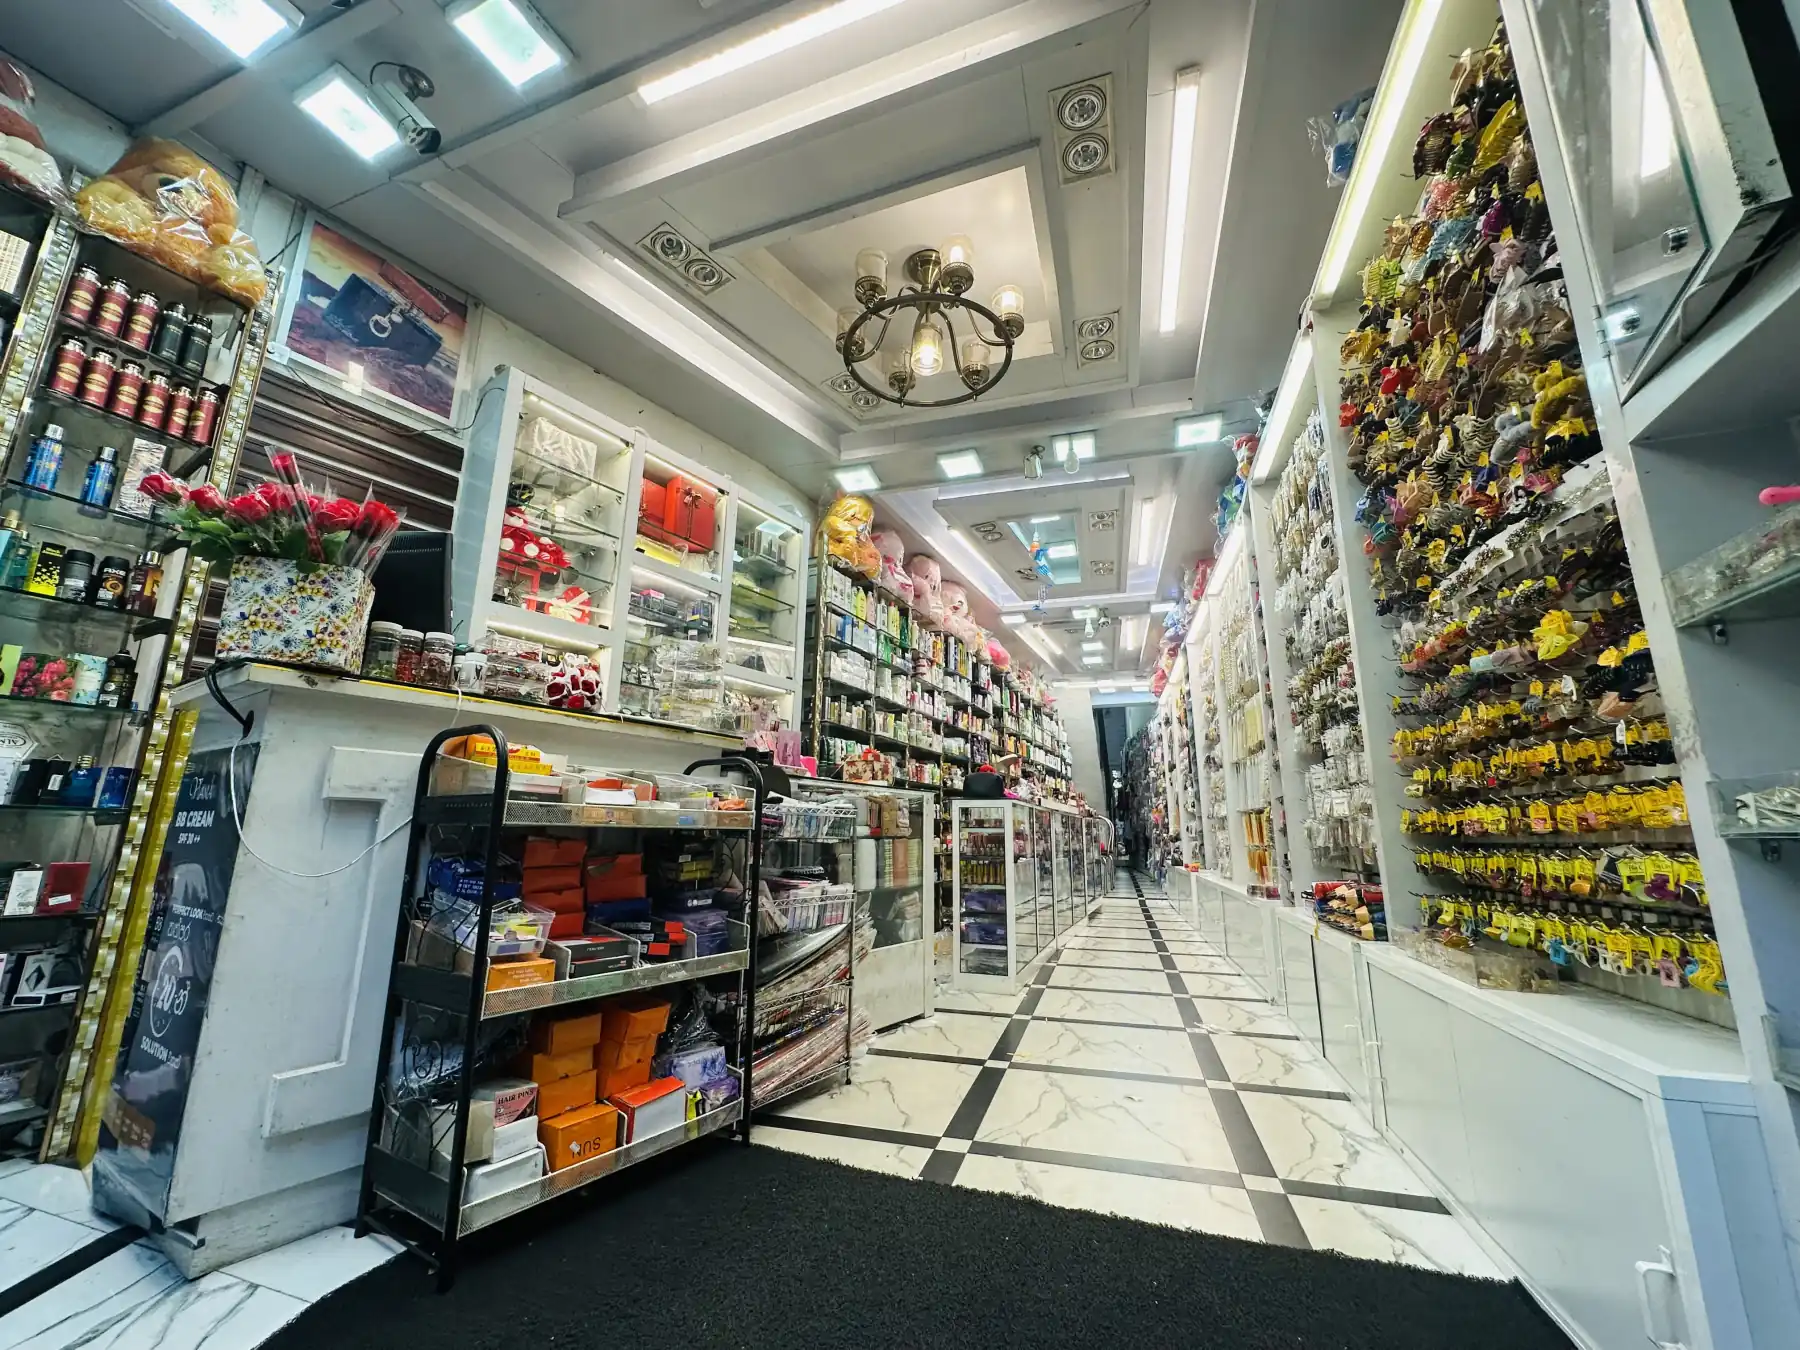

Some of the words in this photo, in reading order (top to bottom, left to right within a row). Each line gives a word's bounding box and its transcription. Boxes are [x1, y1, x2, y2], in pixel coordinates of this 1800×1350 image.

[103, 567, 127, 576] AXE
[175, 812, 186, 827] BB
[187, 810, 215, 827] CREAM
[178, 832, 187, 844] SPF
[189, 907, 203, 919] LOOK
[140, 1035, 168, 1062] SOLUTION
[498, 1094, 516, 1105] HAIR
[517, 1089, 534, 1099] PINS
